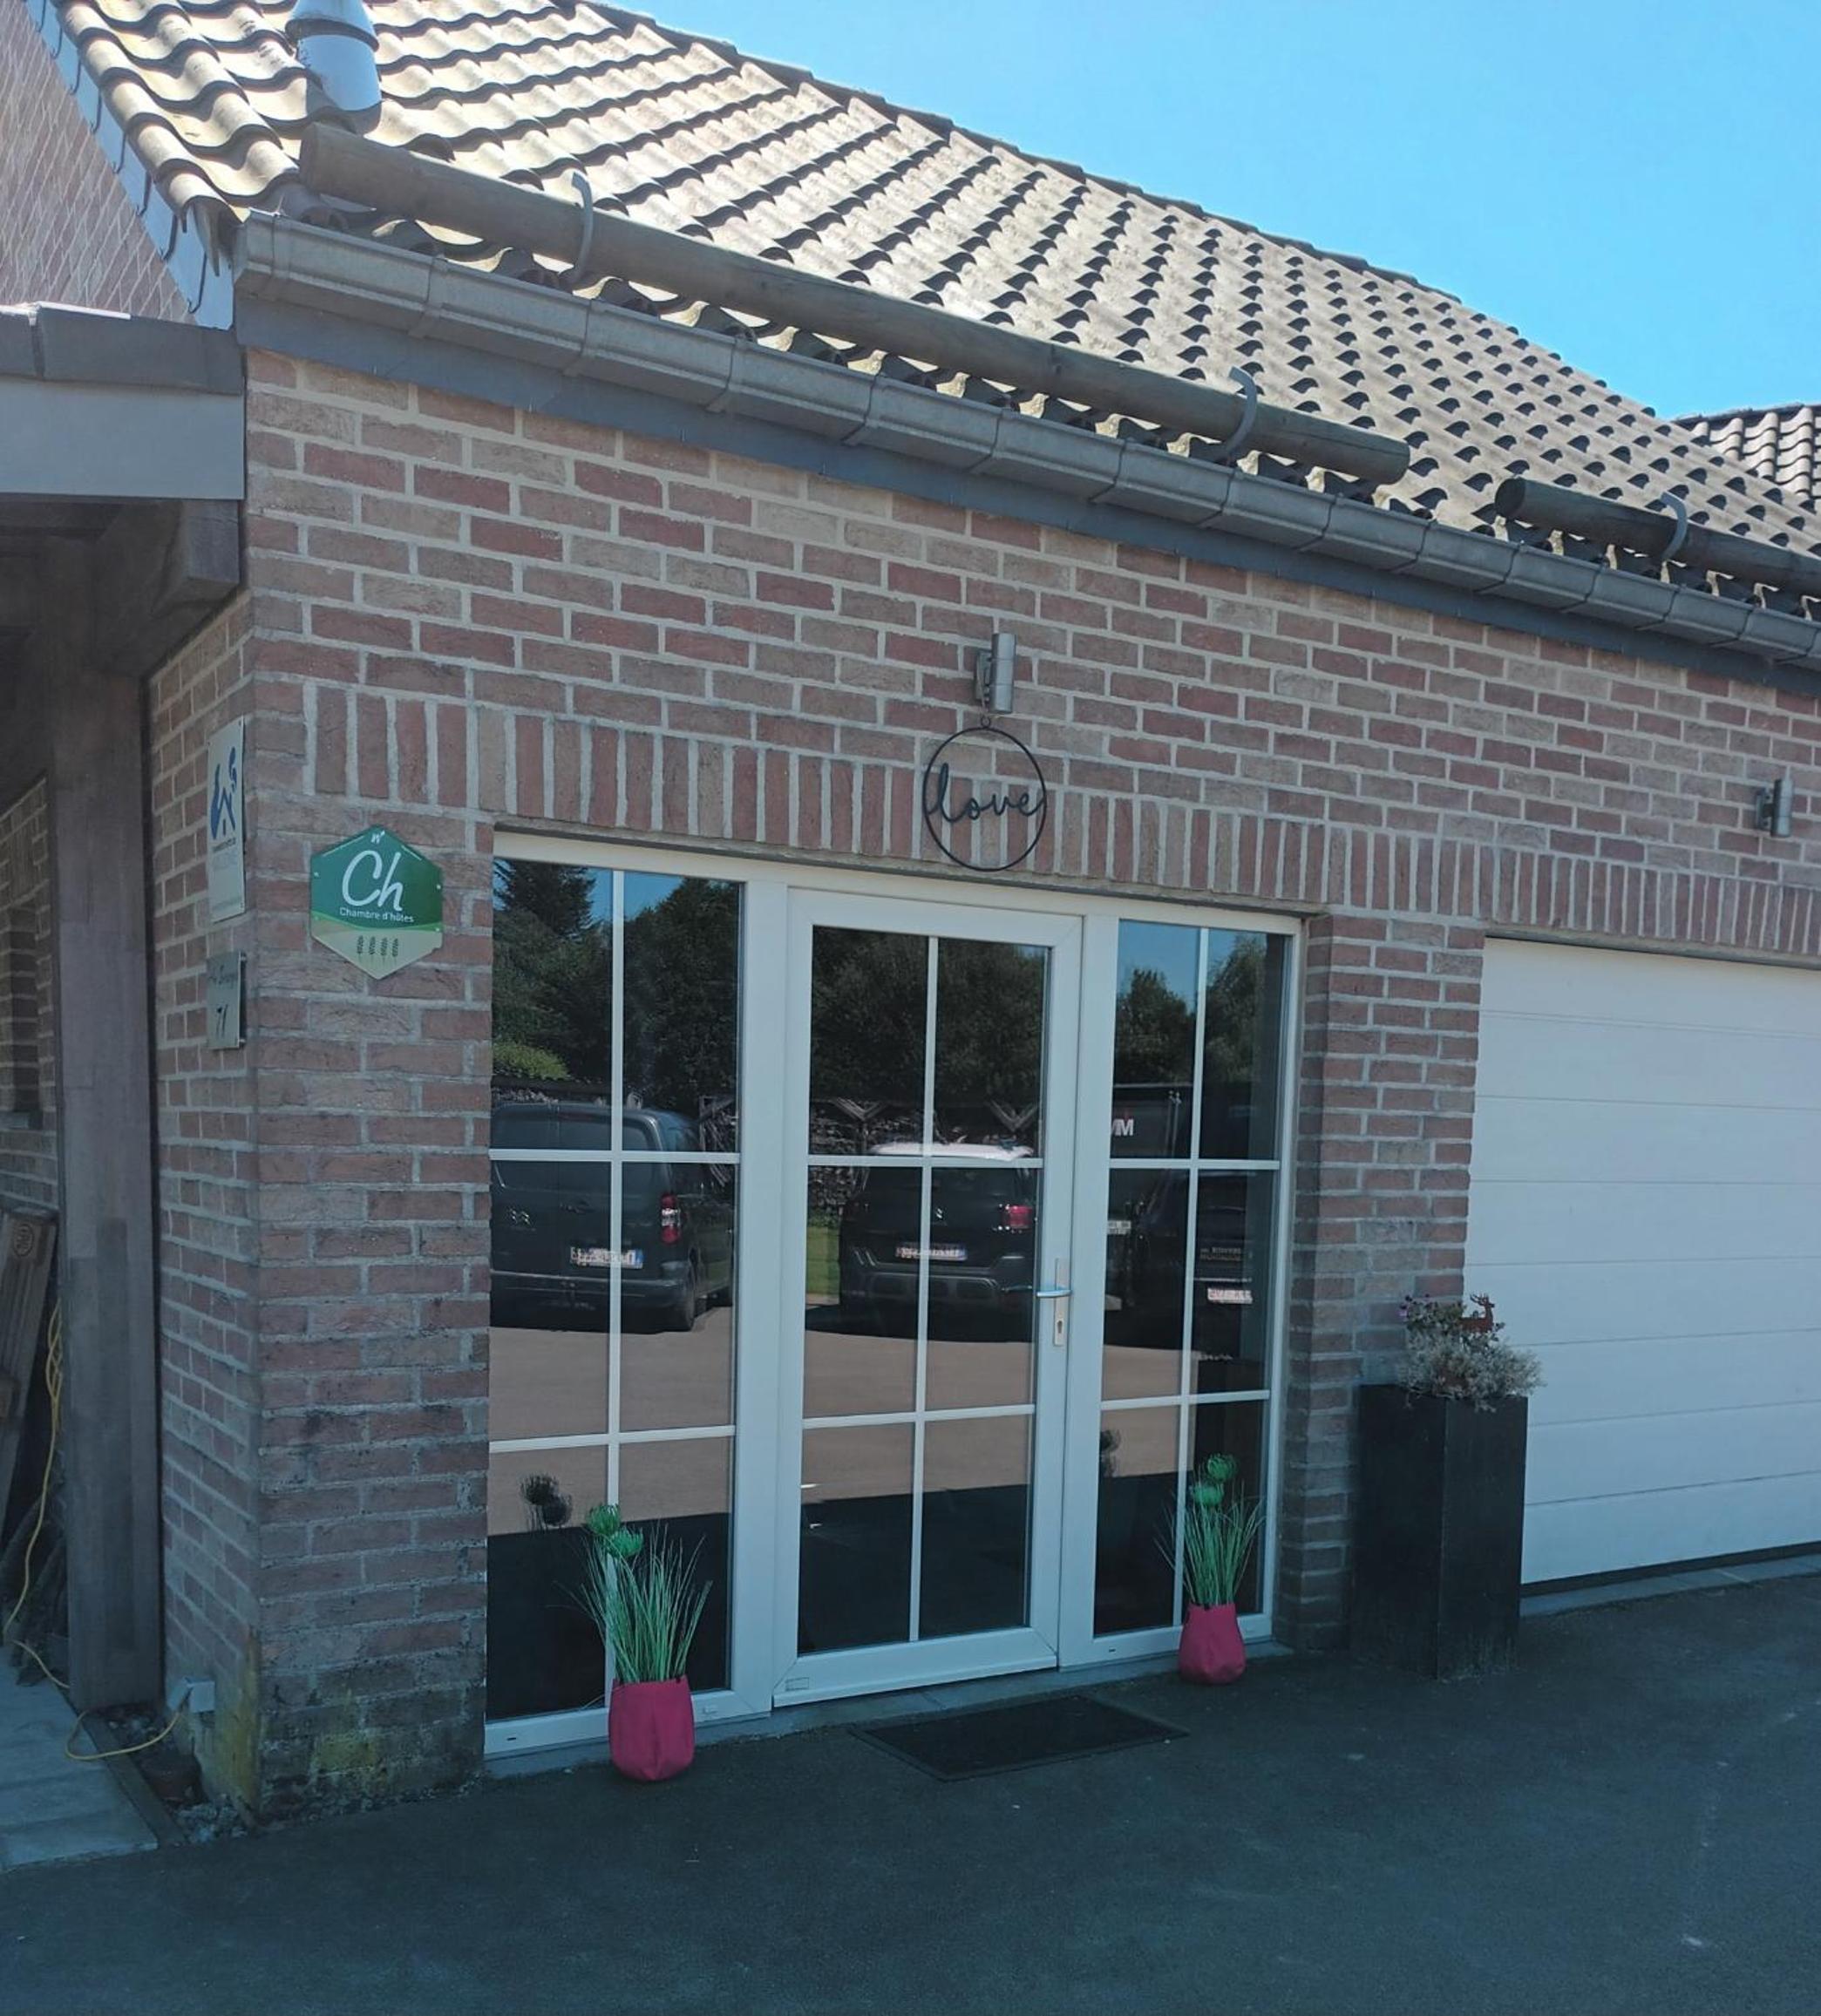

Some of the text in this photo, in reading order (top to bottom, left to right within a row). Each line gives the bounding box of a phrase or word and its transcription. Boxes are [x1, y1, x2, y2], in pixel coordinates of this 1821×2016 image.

[926, 763, 1045, 823] love
[342, 850, 403, 912] Ch
[339, 906, 414, 923] Chambre d'hôtes
